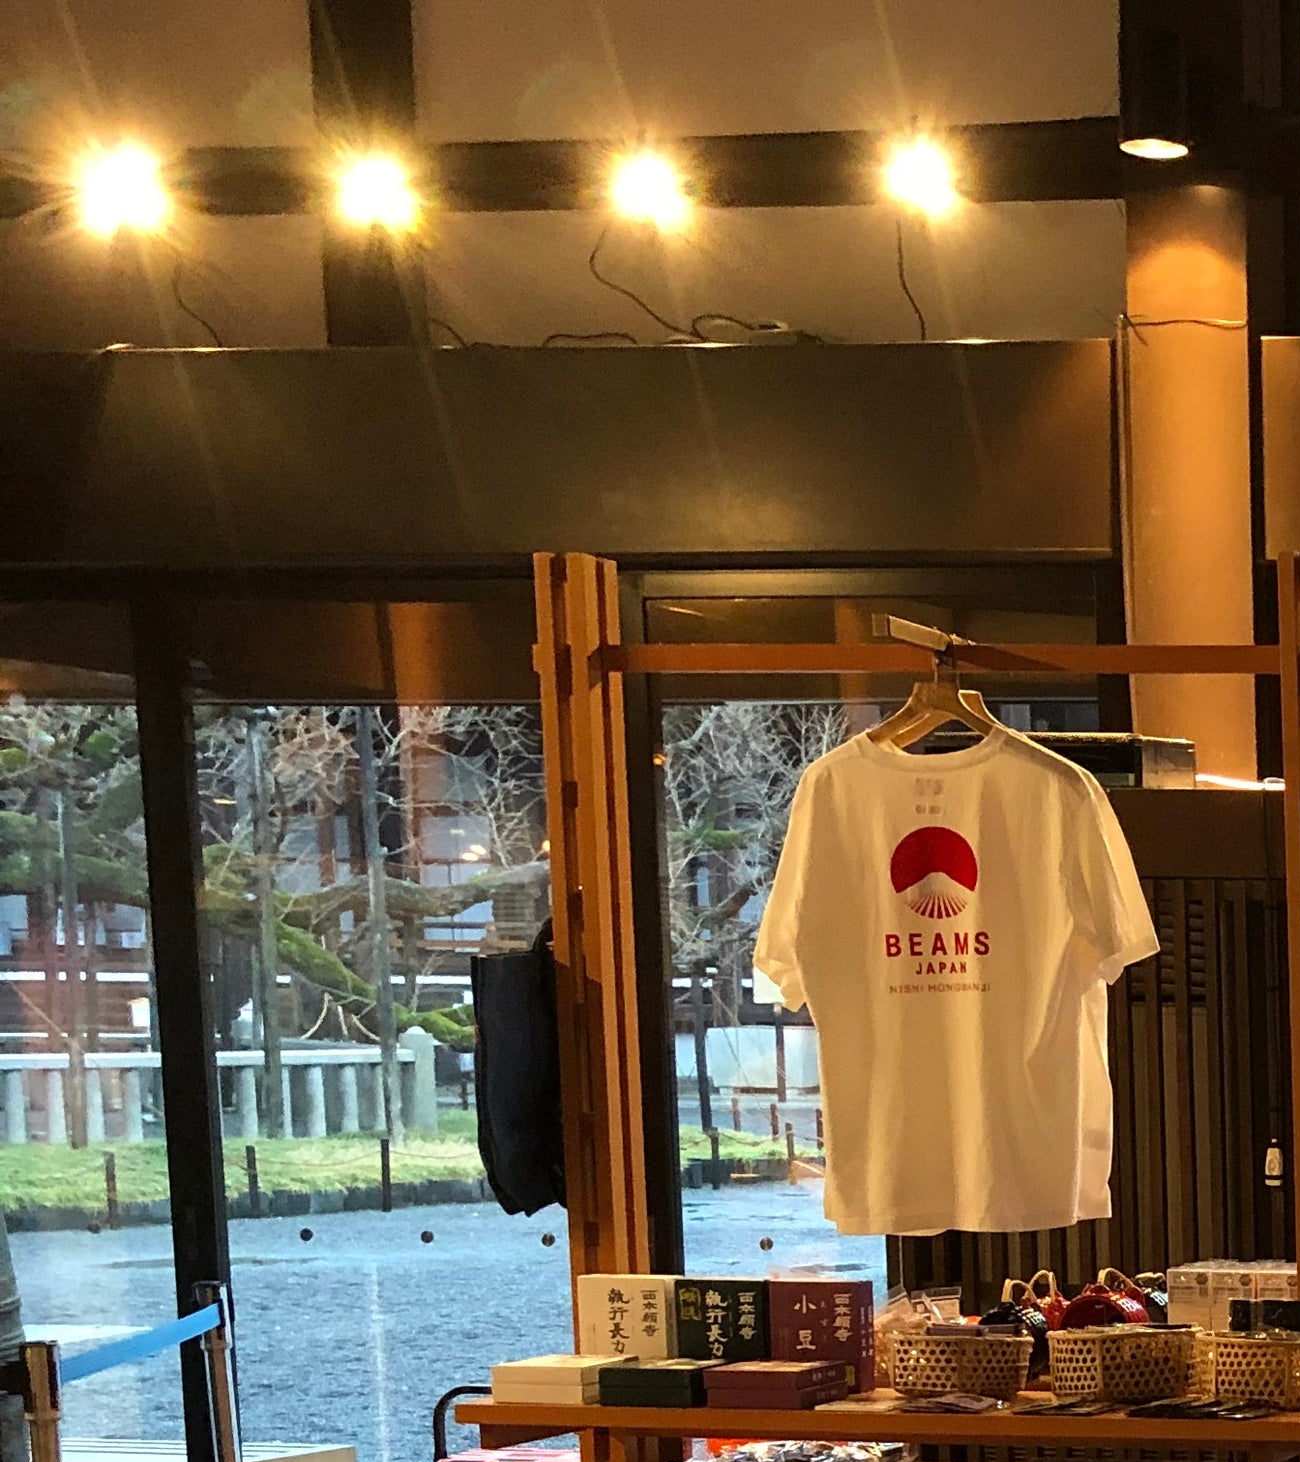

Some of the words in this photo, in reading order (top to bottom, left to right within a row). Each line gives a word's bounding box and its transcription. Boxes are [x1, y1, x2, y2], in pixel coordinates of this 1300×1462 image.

[885, 931, 990, 957] BEAMS
[915, 961, 967, 975] JAPAN
[793, 1294, 817, 1350] 小豆
